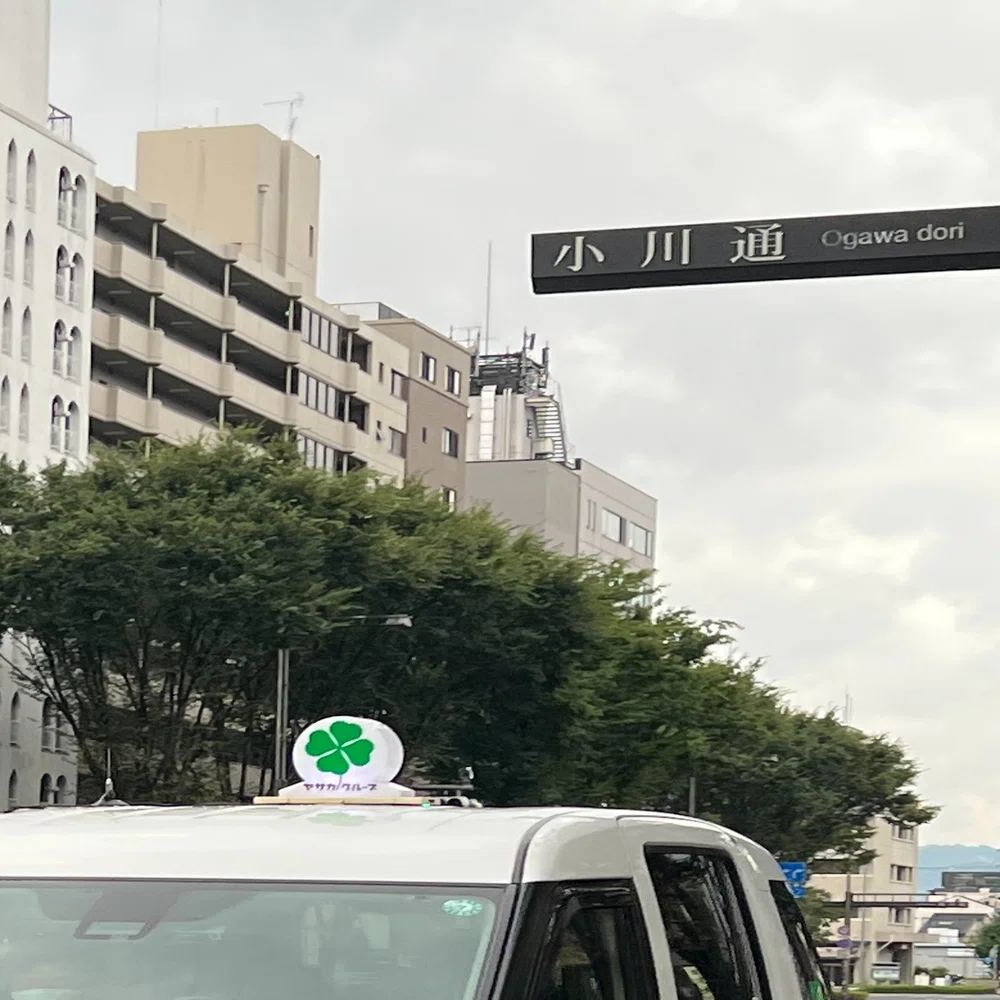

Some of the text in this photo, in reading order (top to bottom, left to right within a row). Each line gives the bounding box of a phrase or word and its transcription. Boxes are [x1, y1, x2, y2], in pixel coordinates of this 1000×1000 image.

[552, 222, 787, 273] 小川通
[820, 221, 965, 250] Ogawa dori
